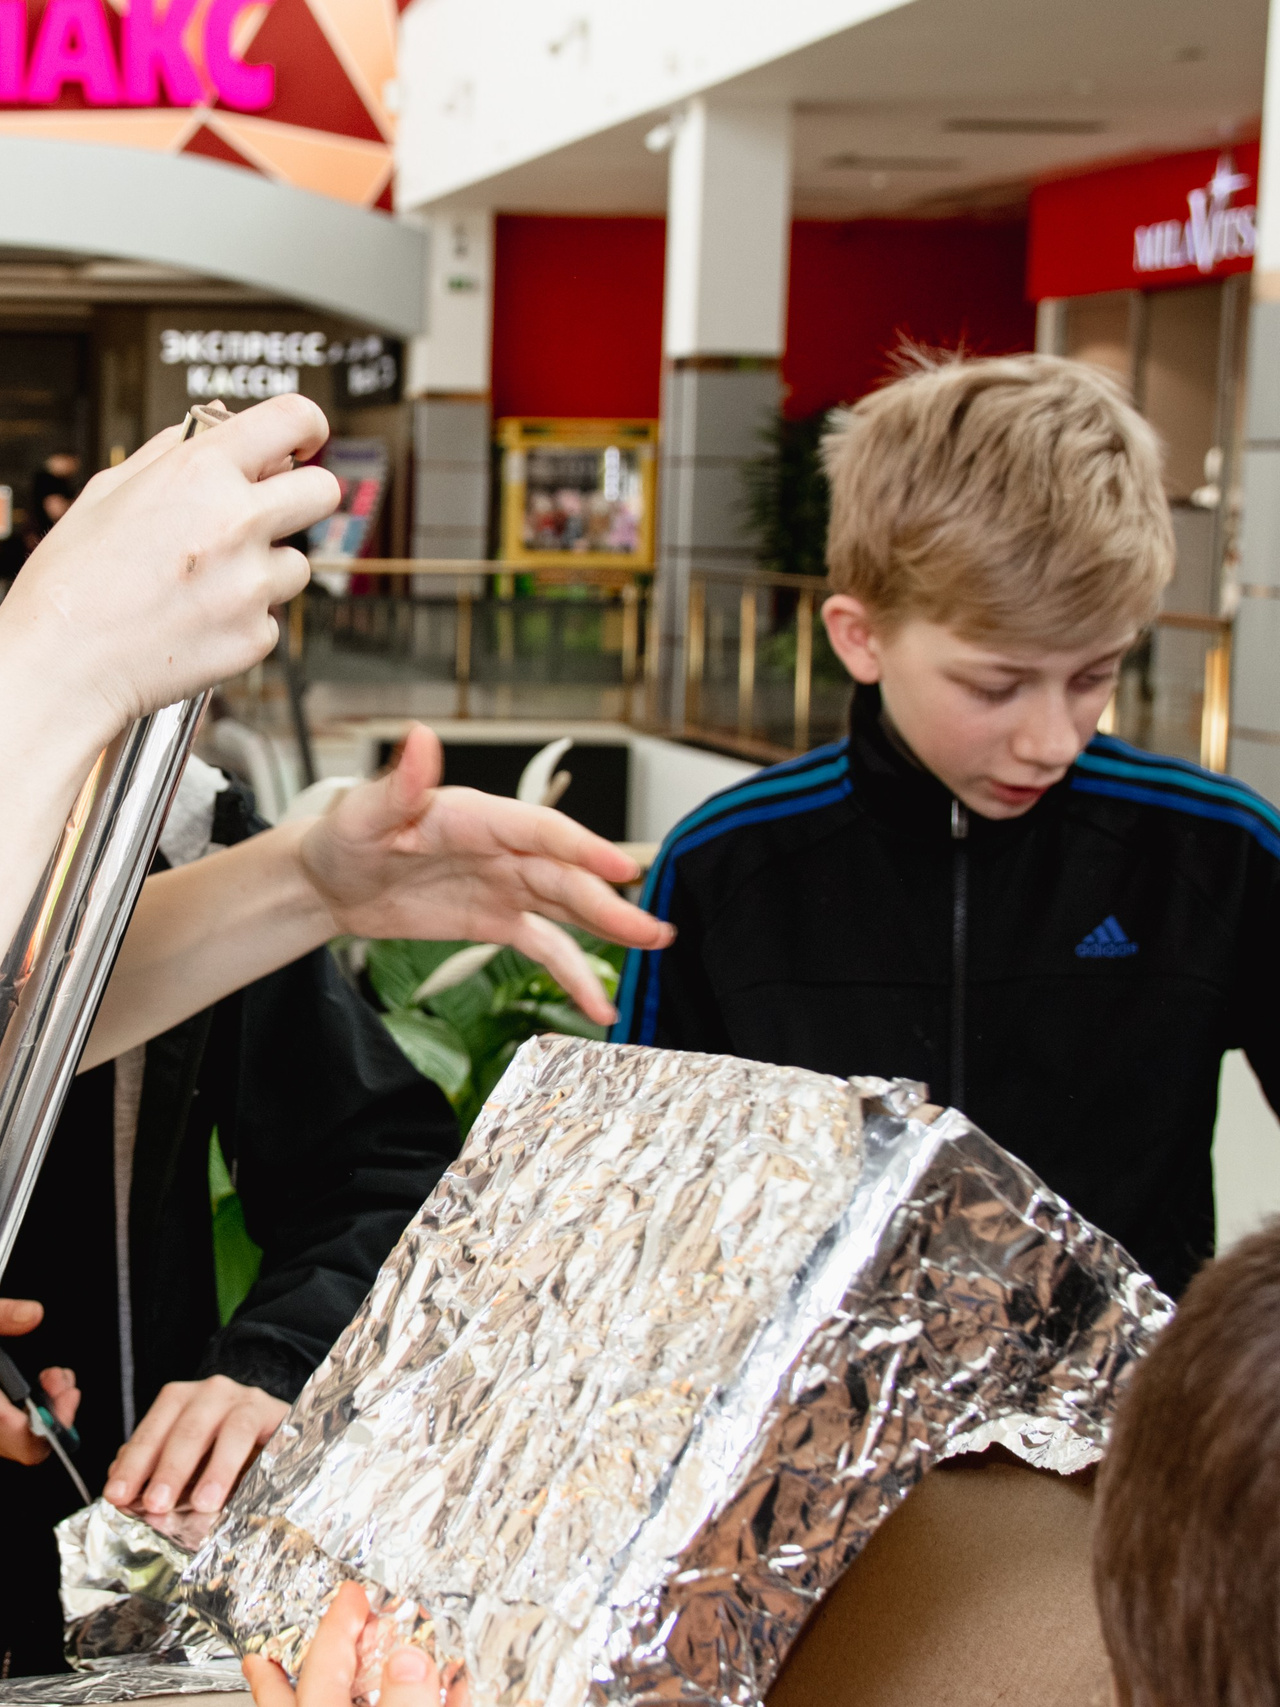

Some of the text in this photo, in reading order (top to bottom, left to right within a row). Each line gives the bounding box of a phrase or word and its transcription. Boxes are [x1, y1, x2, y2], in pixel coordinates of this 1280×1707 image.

[160, 329, 326, 367] ЭКСПРЕСС
[186, 364, 300, 400] КАССЫ
[1074, 942, 1139, 958] adidas
